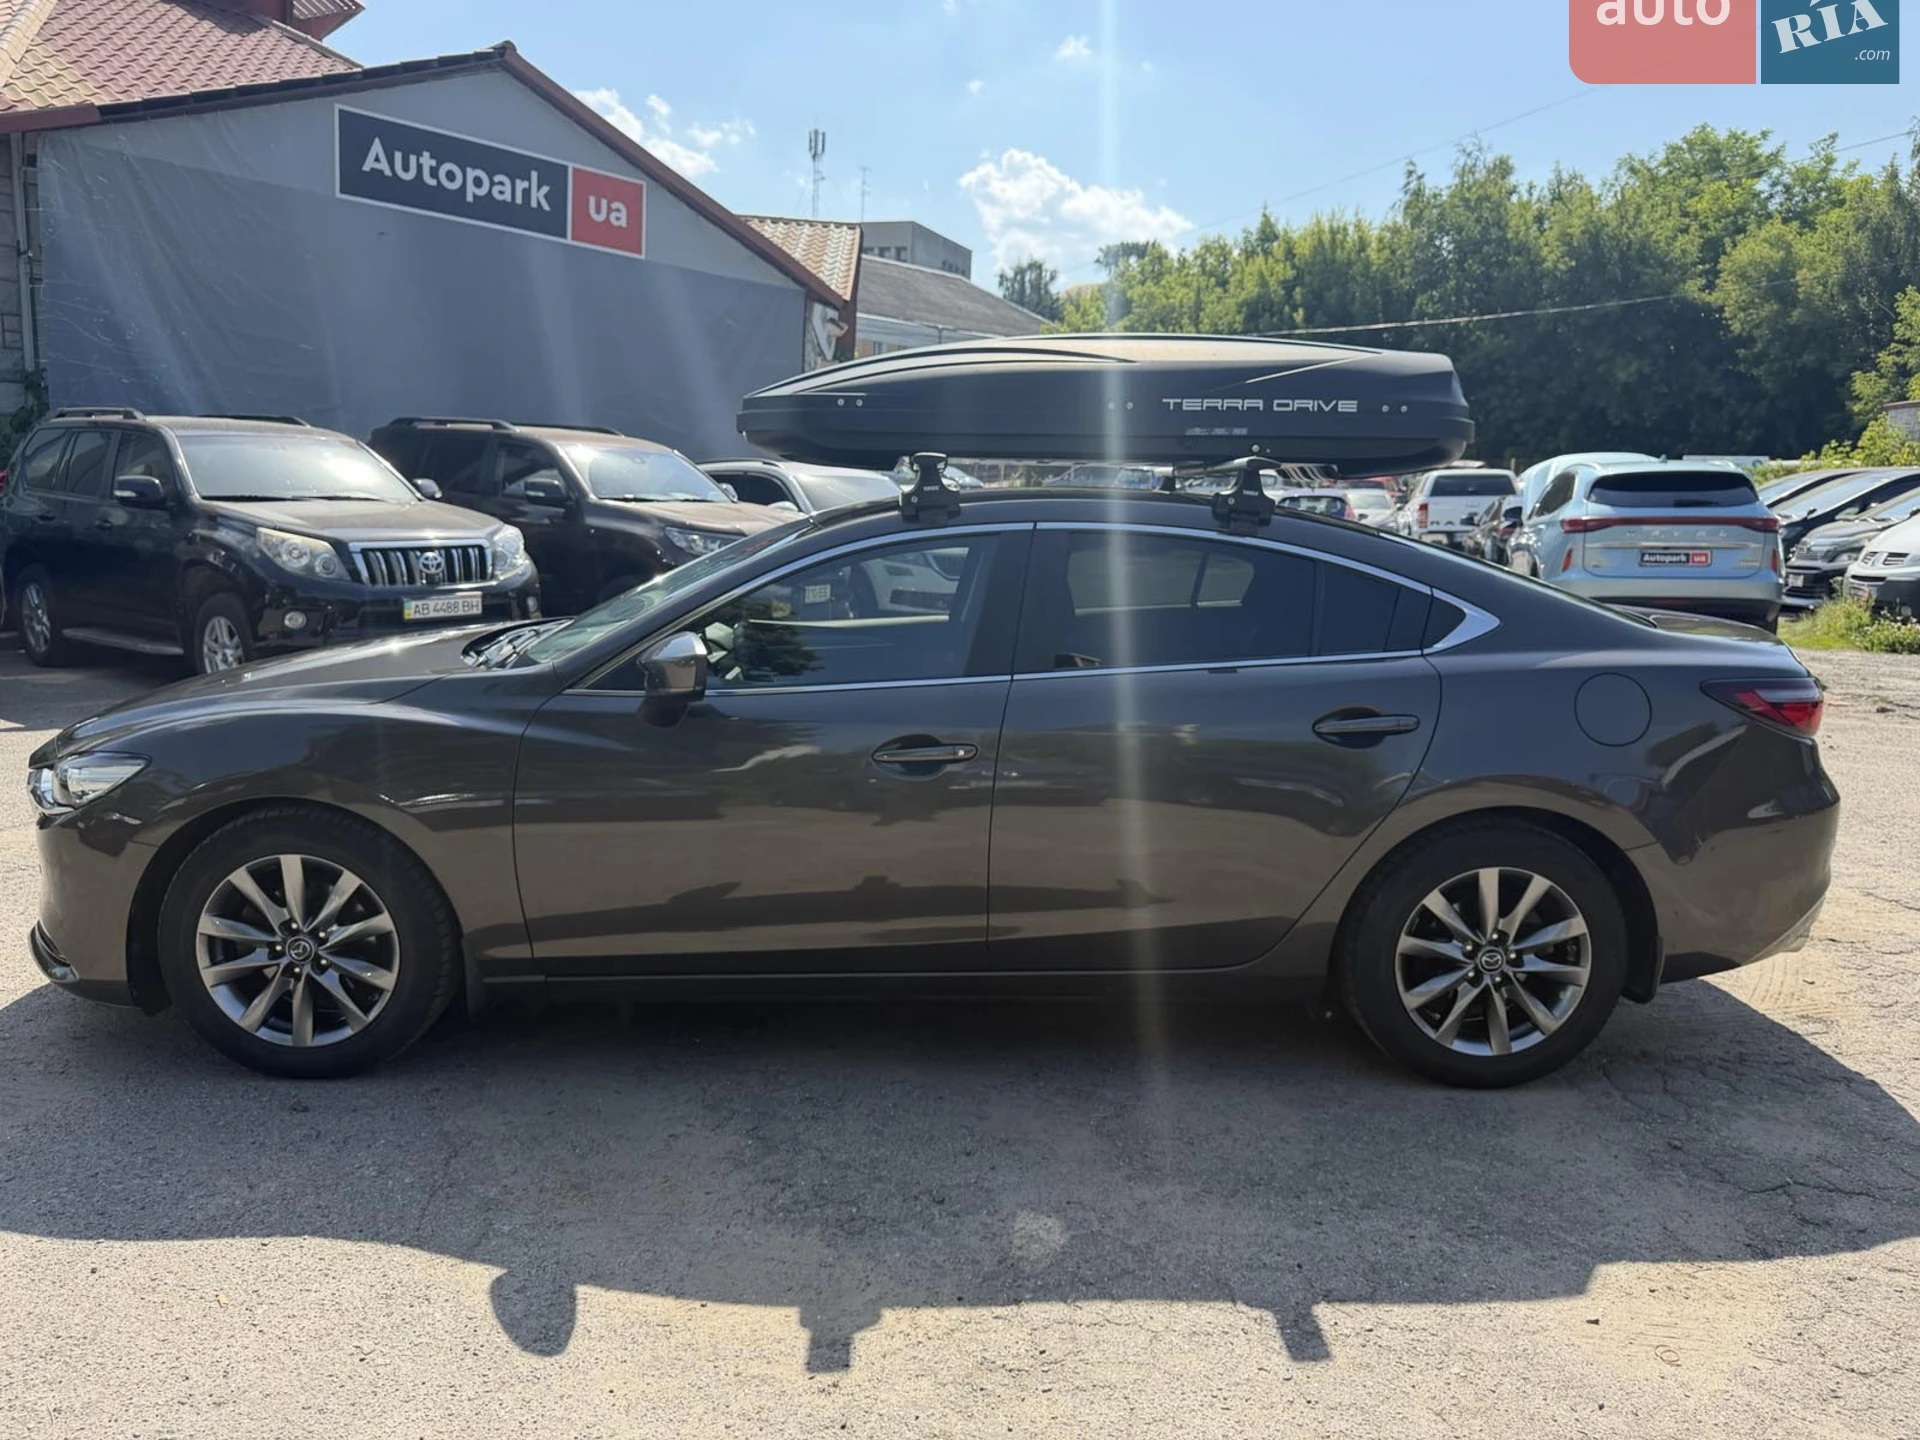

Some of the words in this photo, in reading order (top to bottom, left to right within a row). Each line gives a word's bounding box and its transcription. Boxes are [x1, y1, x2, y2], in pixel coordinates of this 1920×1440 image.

[361, 136, 551, 212] Autopark
[588, 195, 628, 228] ua
[1162, 398, 1263, 411] TERRA
[1273, 399, 1358, 412] DRIVE
[1643, 553, 1687, 563] Autopark
[414, 603, 430, 616] AB
[432, 601, 459, 614] 4488
[462, 600, 480, 613] BH
